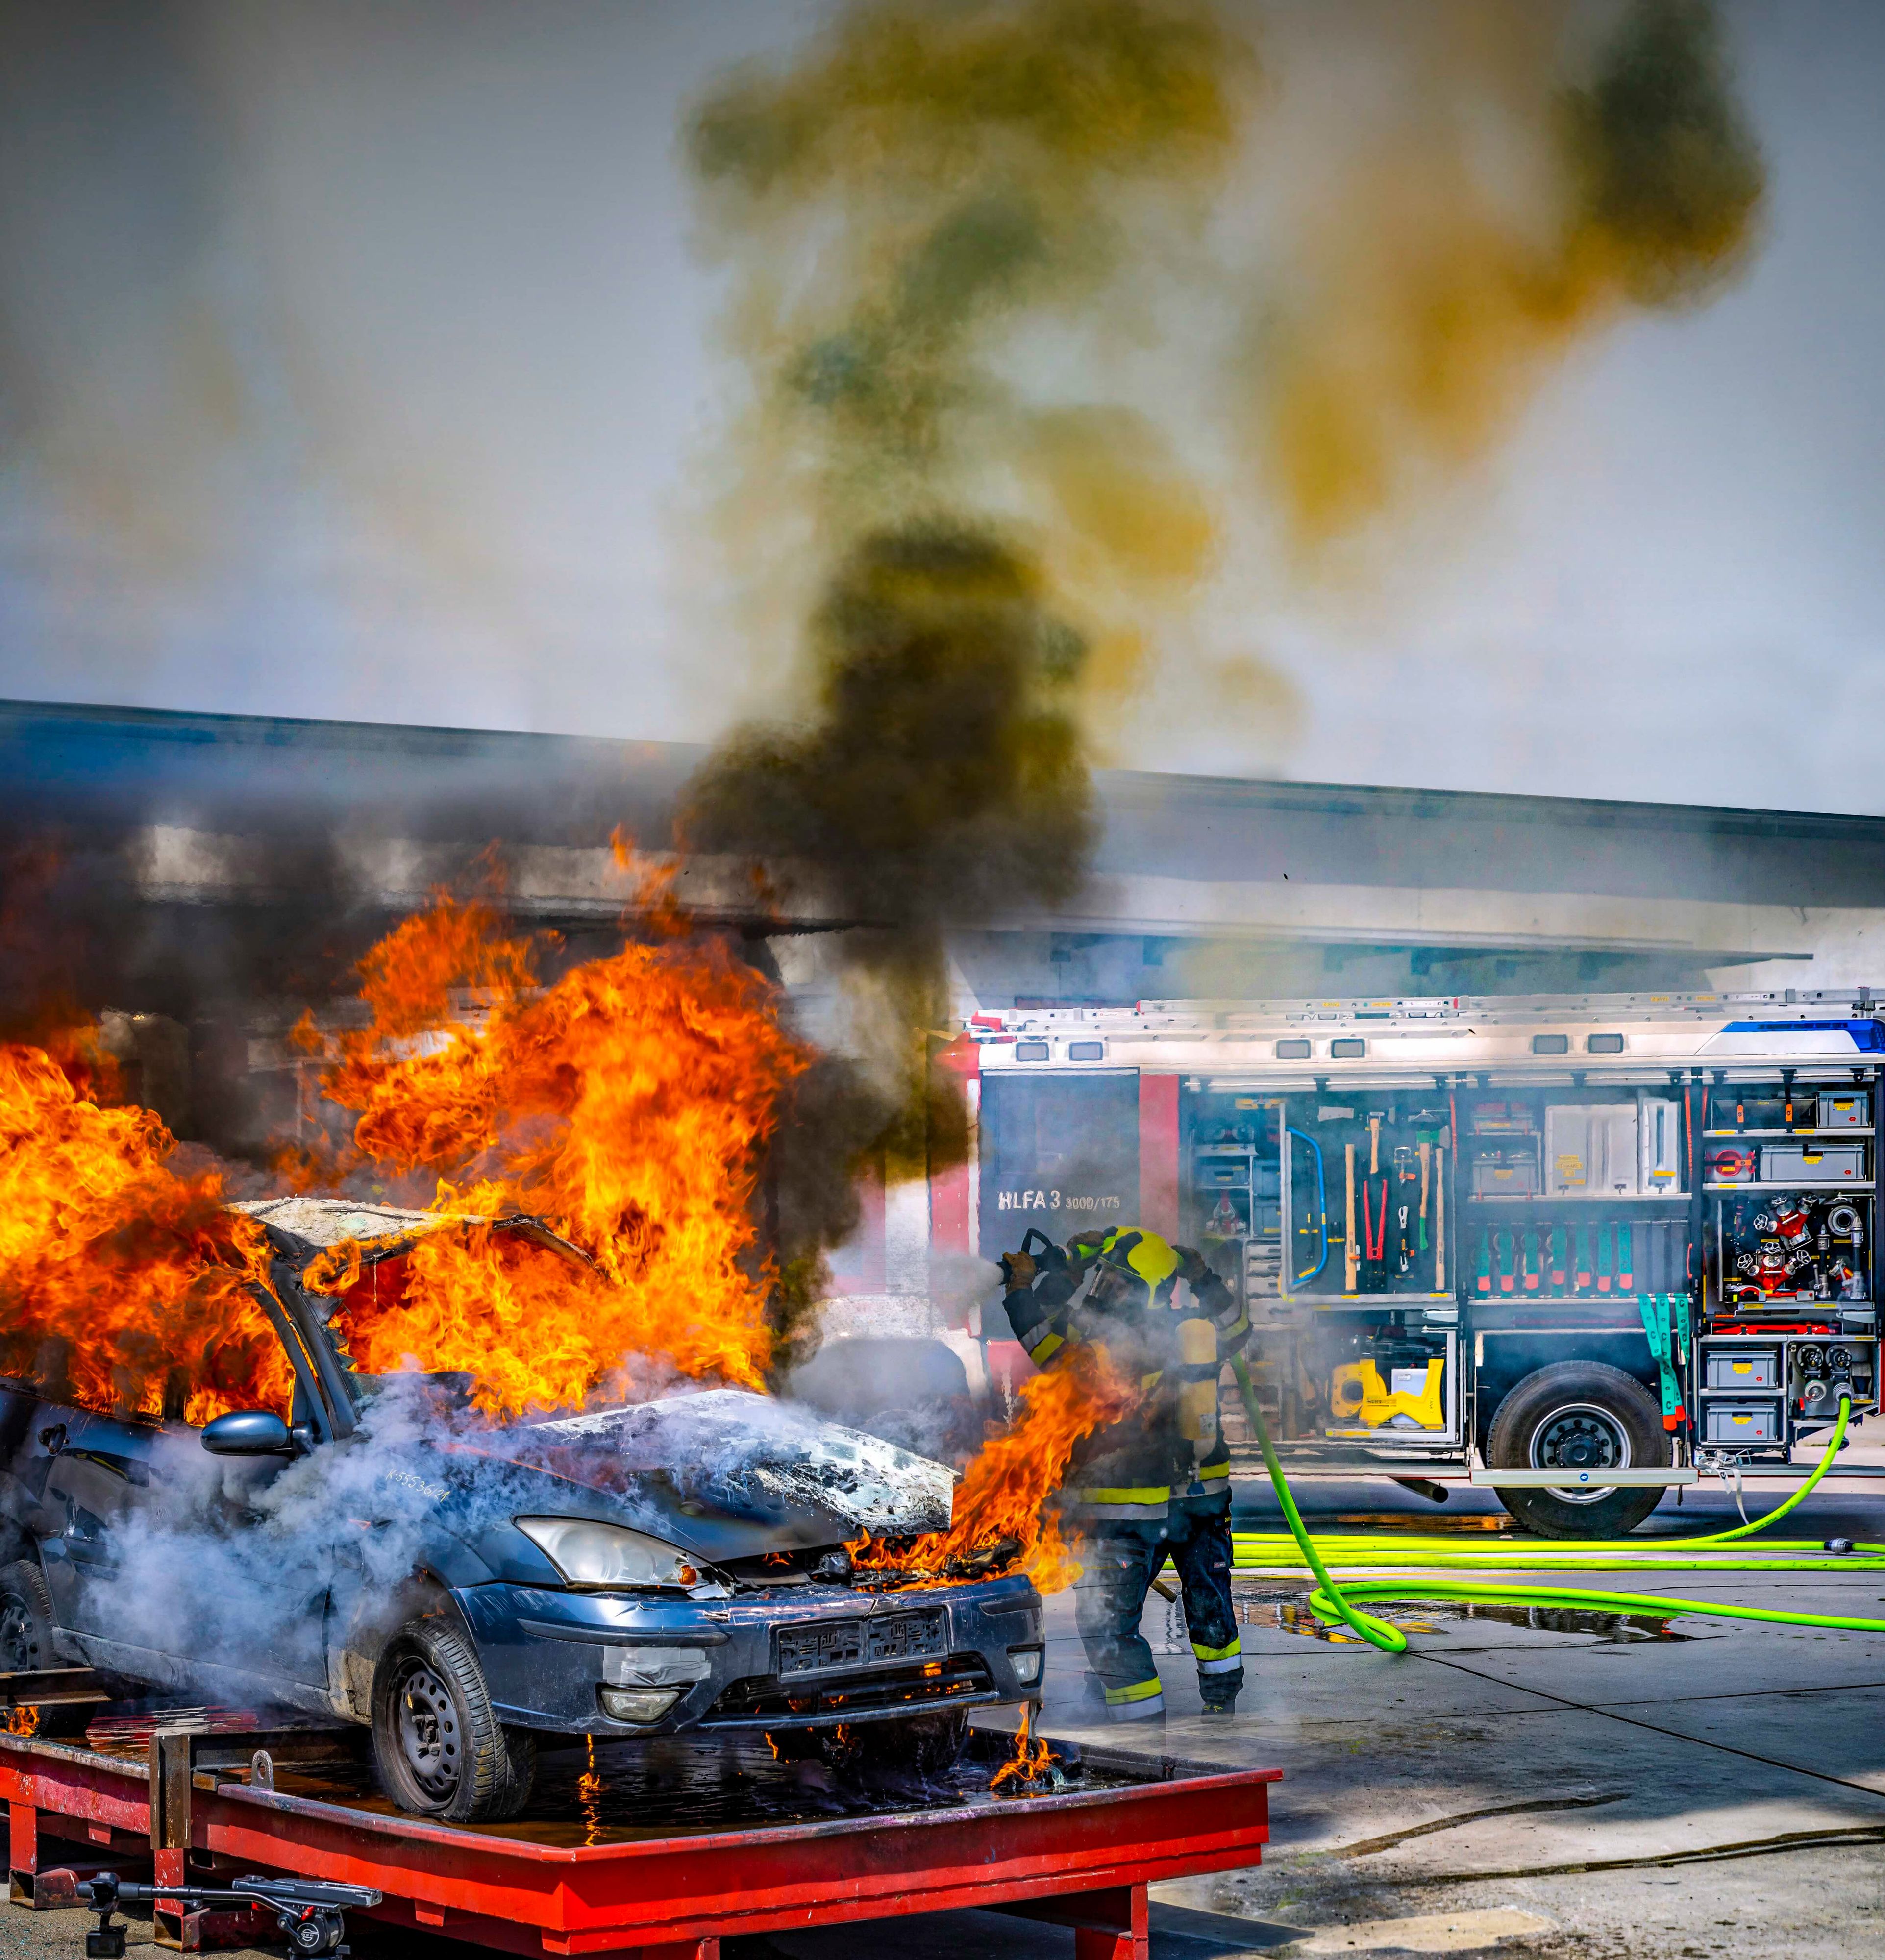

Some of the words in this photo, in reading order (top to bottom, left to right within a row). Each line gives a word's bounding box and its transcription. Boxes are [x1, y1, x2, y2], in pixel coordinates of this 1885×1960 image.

[998, 1190, 1047, 1210] HLFA
[1050, 1190, 1061, 1210] 3
[1065, 1196, 1120, 1211] 3000/175
